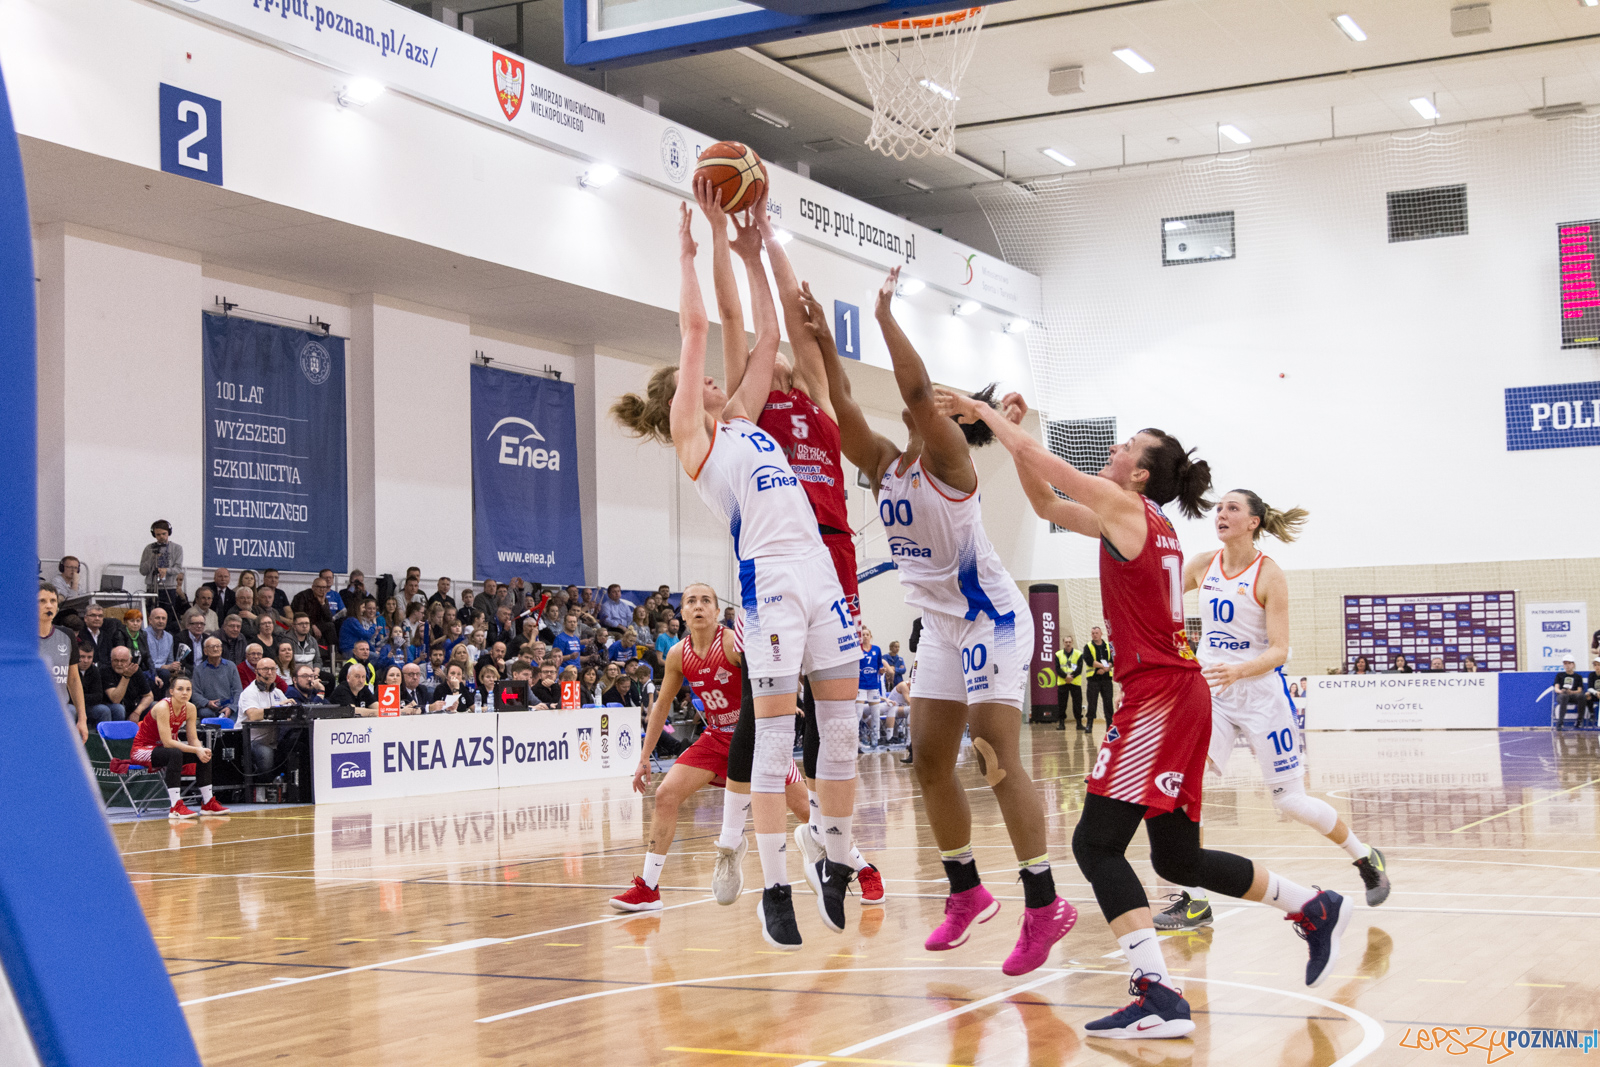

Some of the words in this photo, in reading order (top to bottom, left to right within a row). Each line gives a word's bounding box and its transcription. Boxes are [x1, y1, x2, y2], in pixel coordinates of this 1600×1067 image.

[530, 83, 563, 109] SAMORZĄD
[563, 97, 606, 125] WOJEWÓDZTWA
[530, 100, 584, 133] WIELKOPOLSKIEGO
[177, 99, 208, 172] 2
[799, 197, 916, 264] cspp.put.poznan.pl
[842, 309, 853, 353] 1
[216, 381, 235, 401] 100
[239, 385, 264, 404] LAT
[214, 419, 286, 444] WYŻSZEGO
[790, 414, 809, 439] 5
[498, 435, 560, 471] Enea
[757, 474, 797, 492] Enea
[213, 498, 308, 522] TECHNICZNEGO
[880, 499, 913, 526] 00
[215, 537, 228, 556] W
[497, 550, 556, 568] www.enea.pl
[890, 543, 932, 558] Enea
[831, 597, 855, 629] 13
[1209, 597, 1234, 624] 10
[1041, 612, 1055, 662] Energa
[1209, 637, 1250, 650] Enea
[866, 656, 872, 664] 7
[962, 643, 987, 675] 00
[381, 686, 396, 706] 5
[562, 683, 571, 700] 5
[575, 683, 580, 700] 5
[1318, 680, 1376, 689] CENTRUM
[1380, 678, 1486, 688] KONFERENCYJNE
[701, 689, 729, 710] 88
[383, 738, 447, 774] ENEA
[452, 736, 495, 768] AZS
[502, 732, 570, 765] Poznań
[1266, 728, 1293, 755] 10
[341, 767, 367, 779] Enea
